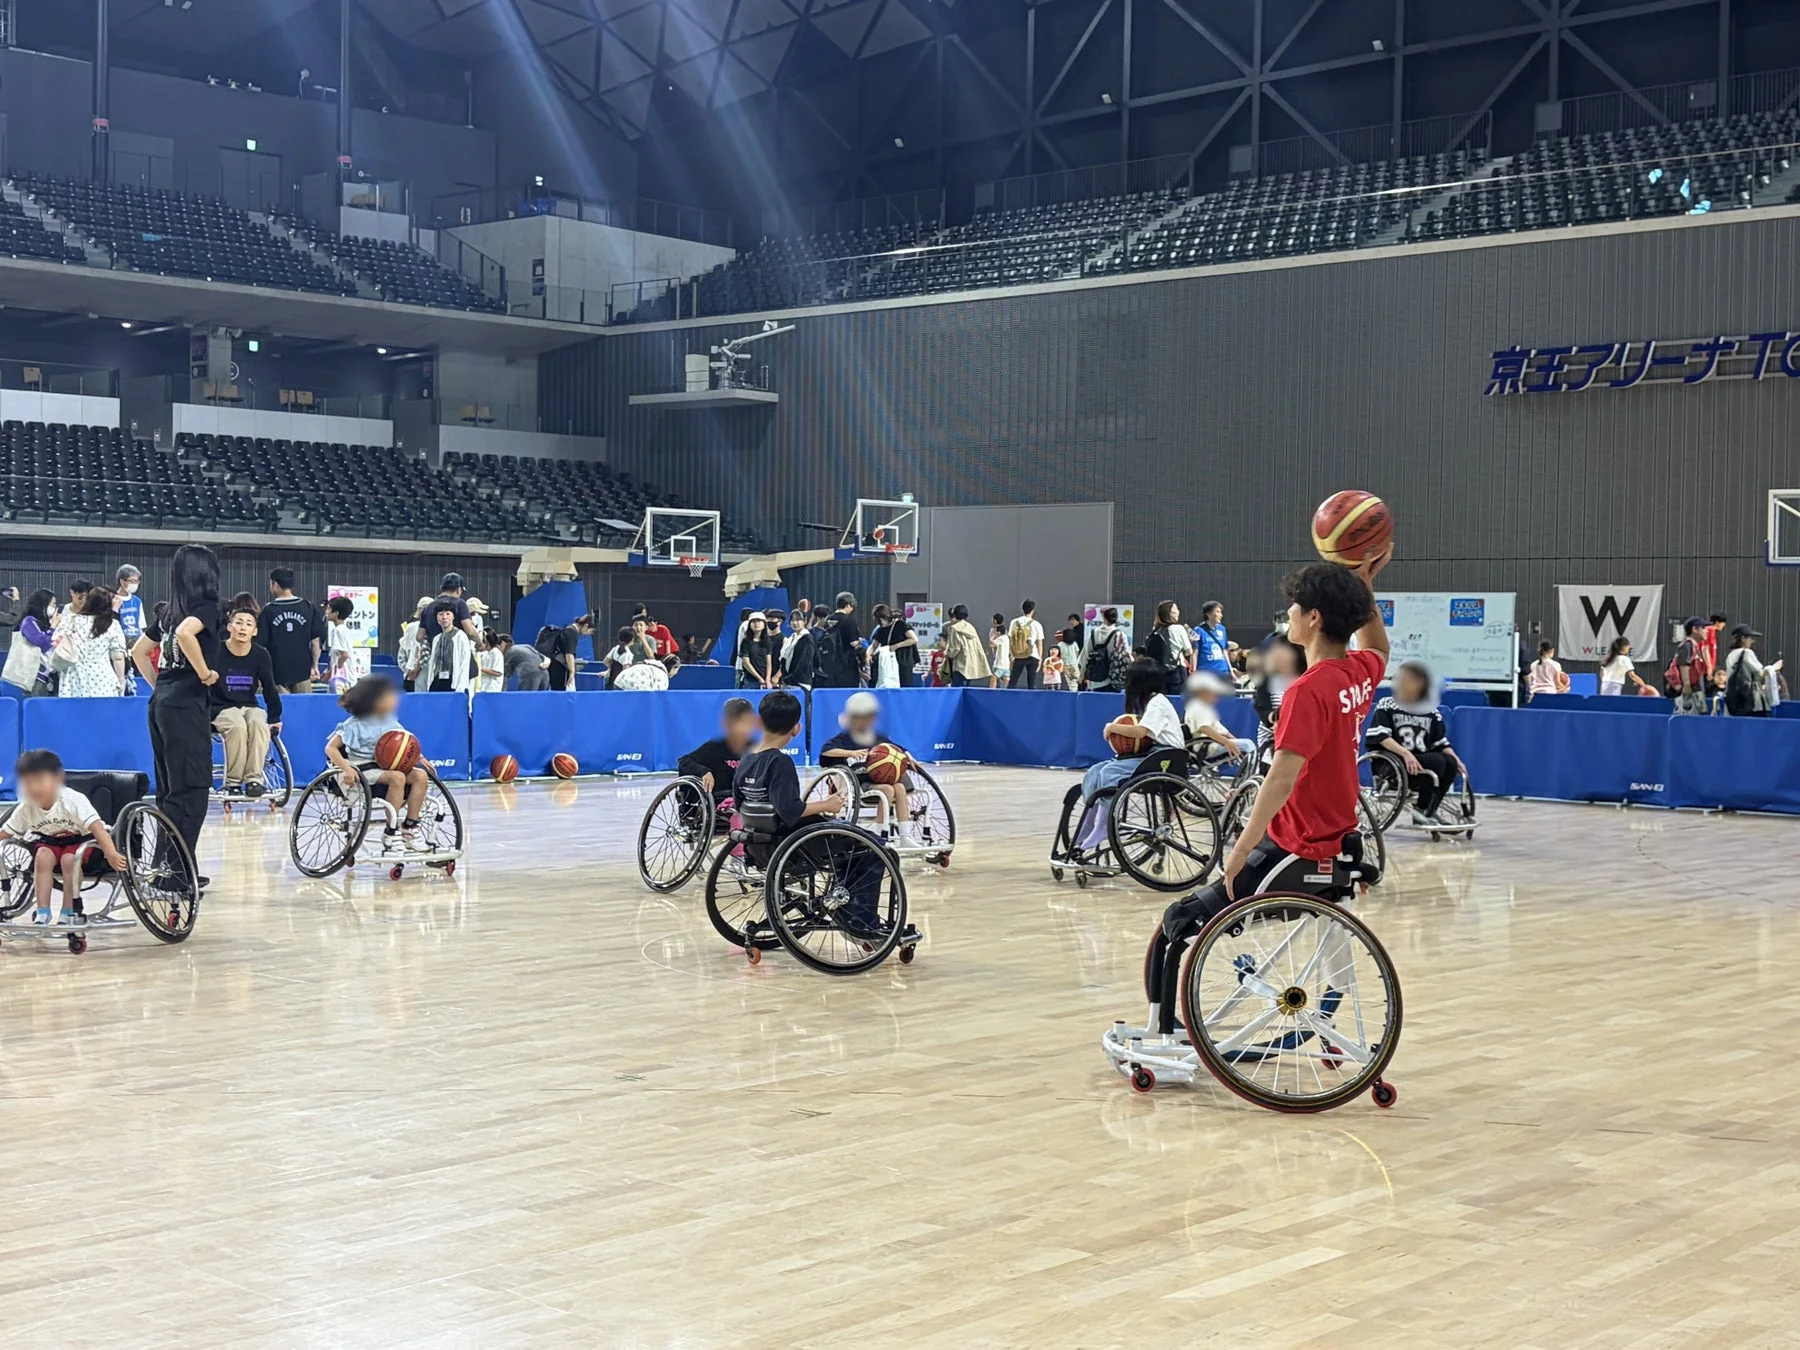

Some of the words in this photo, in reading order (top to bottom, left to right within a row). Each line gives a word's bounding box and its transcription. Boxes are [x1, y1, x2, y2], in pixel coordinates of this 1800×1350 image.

[272, 614, 284, 627] NEW
[283, 611, 307, 626] BALANCE
[1579, 595, 1642, 639] W
